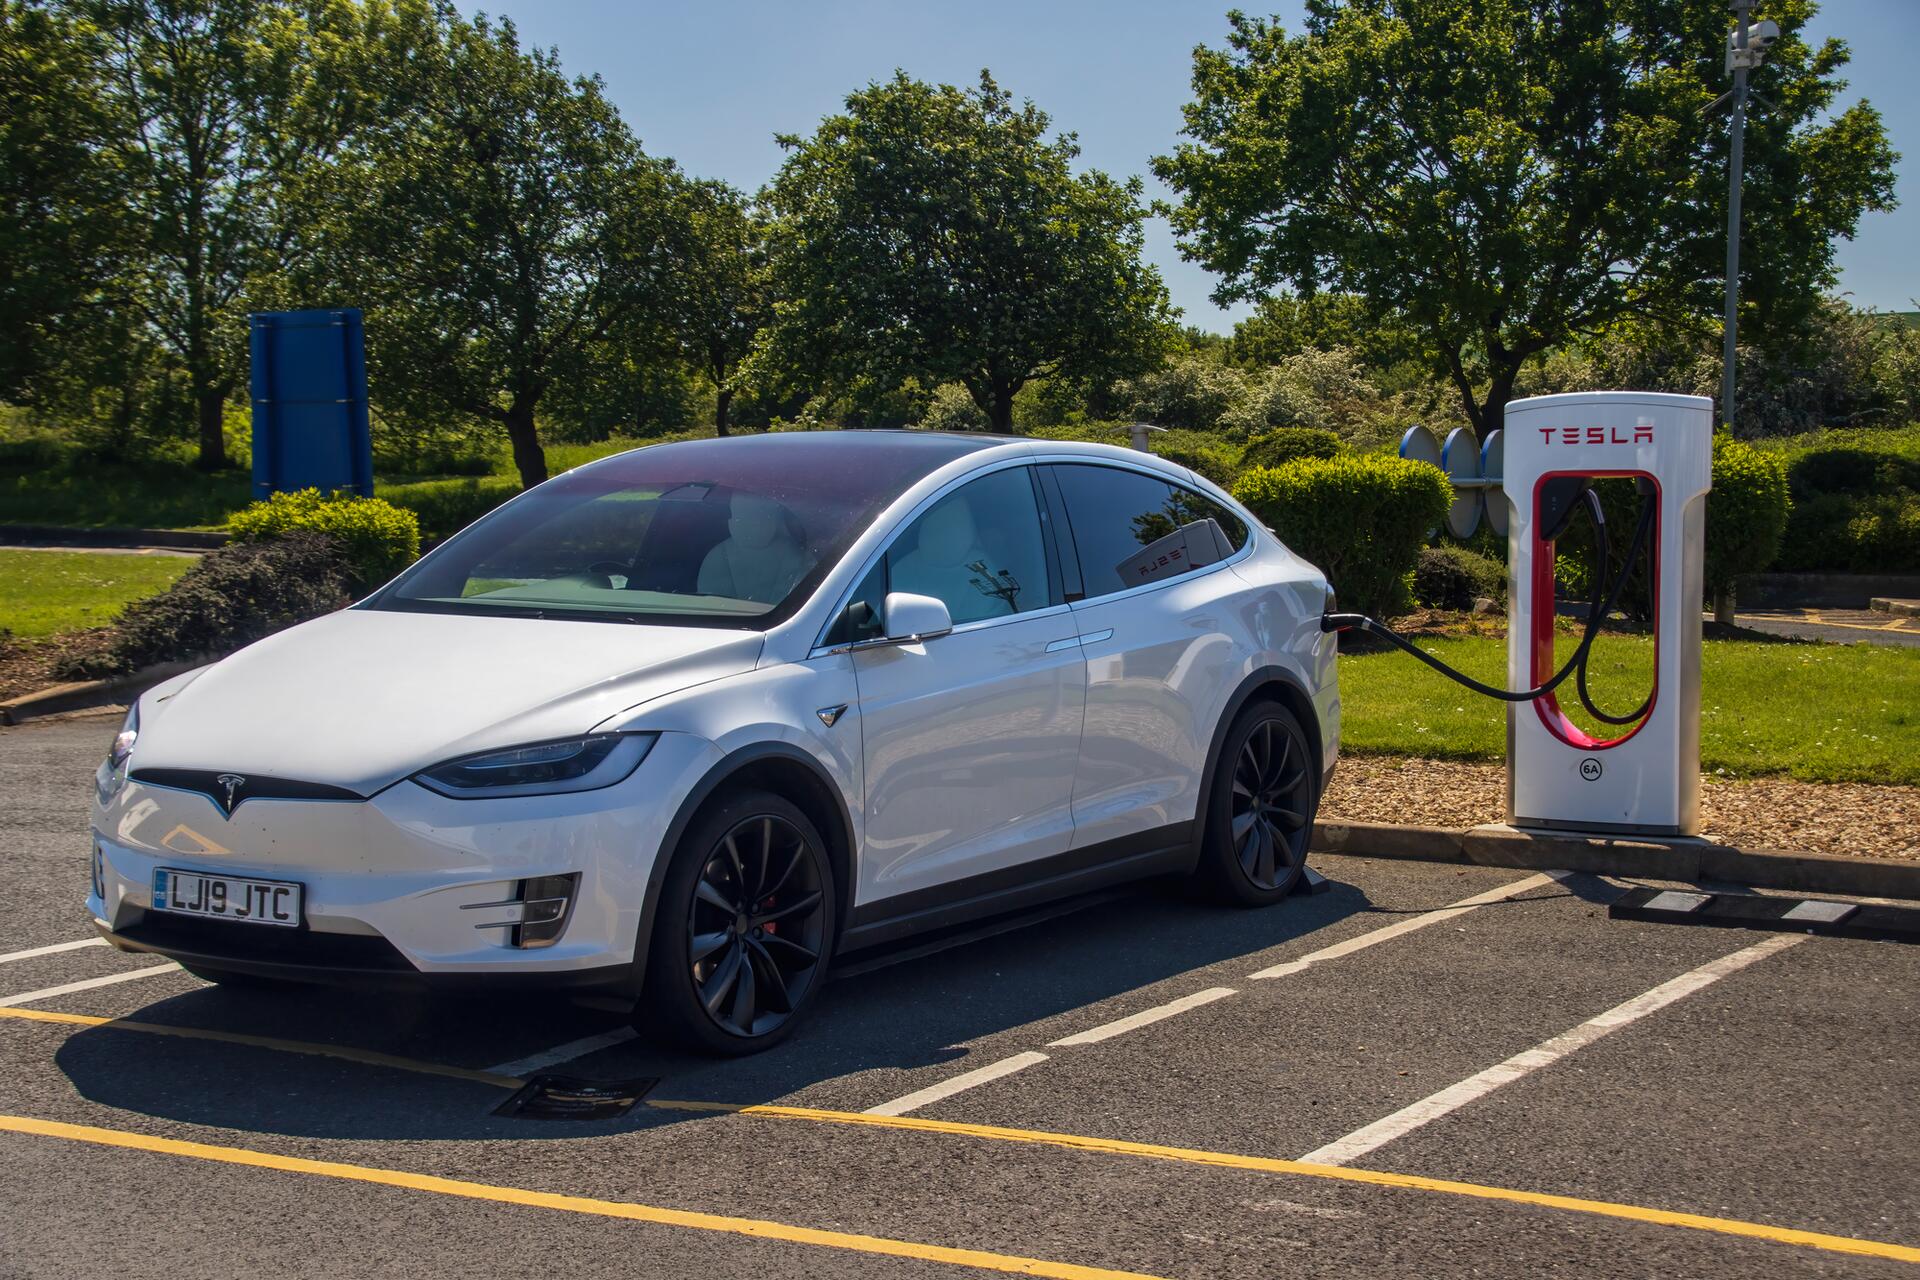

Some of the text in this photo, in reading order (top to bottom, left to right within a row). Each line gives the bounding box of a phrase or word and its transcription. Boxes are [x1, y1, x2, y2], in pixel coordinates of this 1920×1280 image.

[1538, 426, 1654, 445] TESLA
[1583, 764, 1599, 774] 6A
[171, 875, 290, 920] LJ19 JTC
